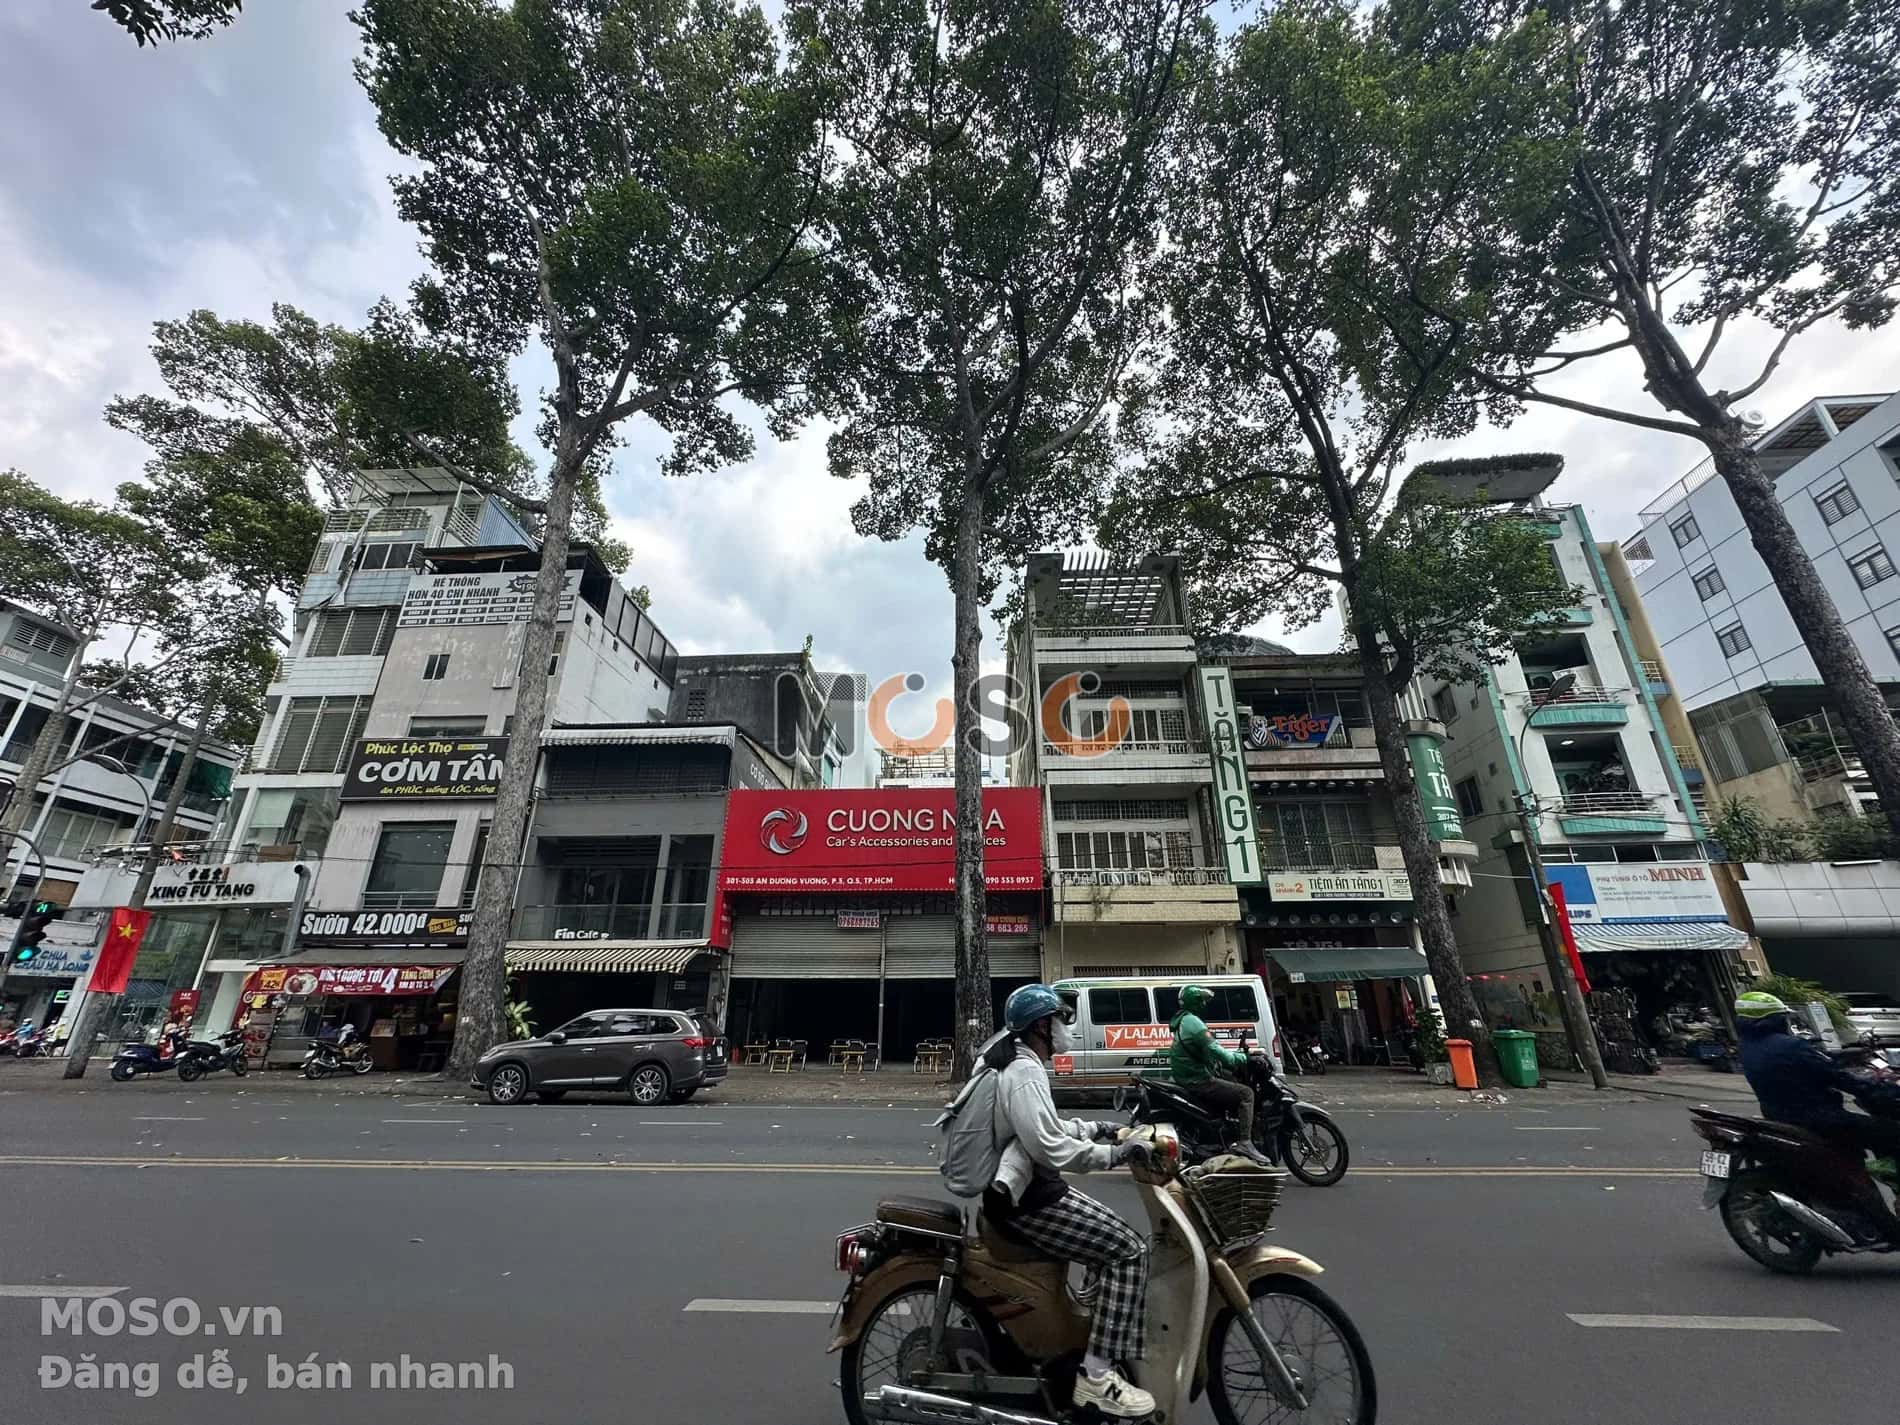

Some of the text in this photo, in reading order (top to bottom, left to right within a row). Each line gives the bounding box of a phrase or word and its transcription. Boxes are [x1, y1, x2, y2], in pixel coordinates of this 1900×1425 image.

[430, 589, 444, 599] 40
[446, 588, 465, 599] CHI
[1272, 712, 1330, 741] Tiger
[358, 758, 441, 783] CƠM
[827, 808, 935, 832] CUONG
[826, 836, 856, 847] Car's
[858, 836, 928, 847] Accessories
[931, 836, 953, 846] and
[755, 877, 767, 885] AN
[864, 876, 893, 885] TP.HCM
[1648, 867, 1706, 882] MINH
[150, 883, 256, 899] XING FU TANG
[1295, 882, 1304, 893] 2
[300, 913, 350, 935] Sườn
[554, 928, 576, 940] Fin
[381, 968, 399, 993] 4
